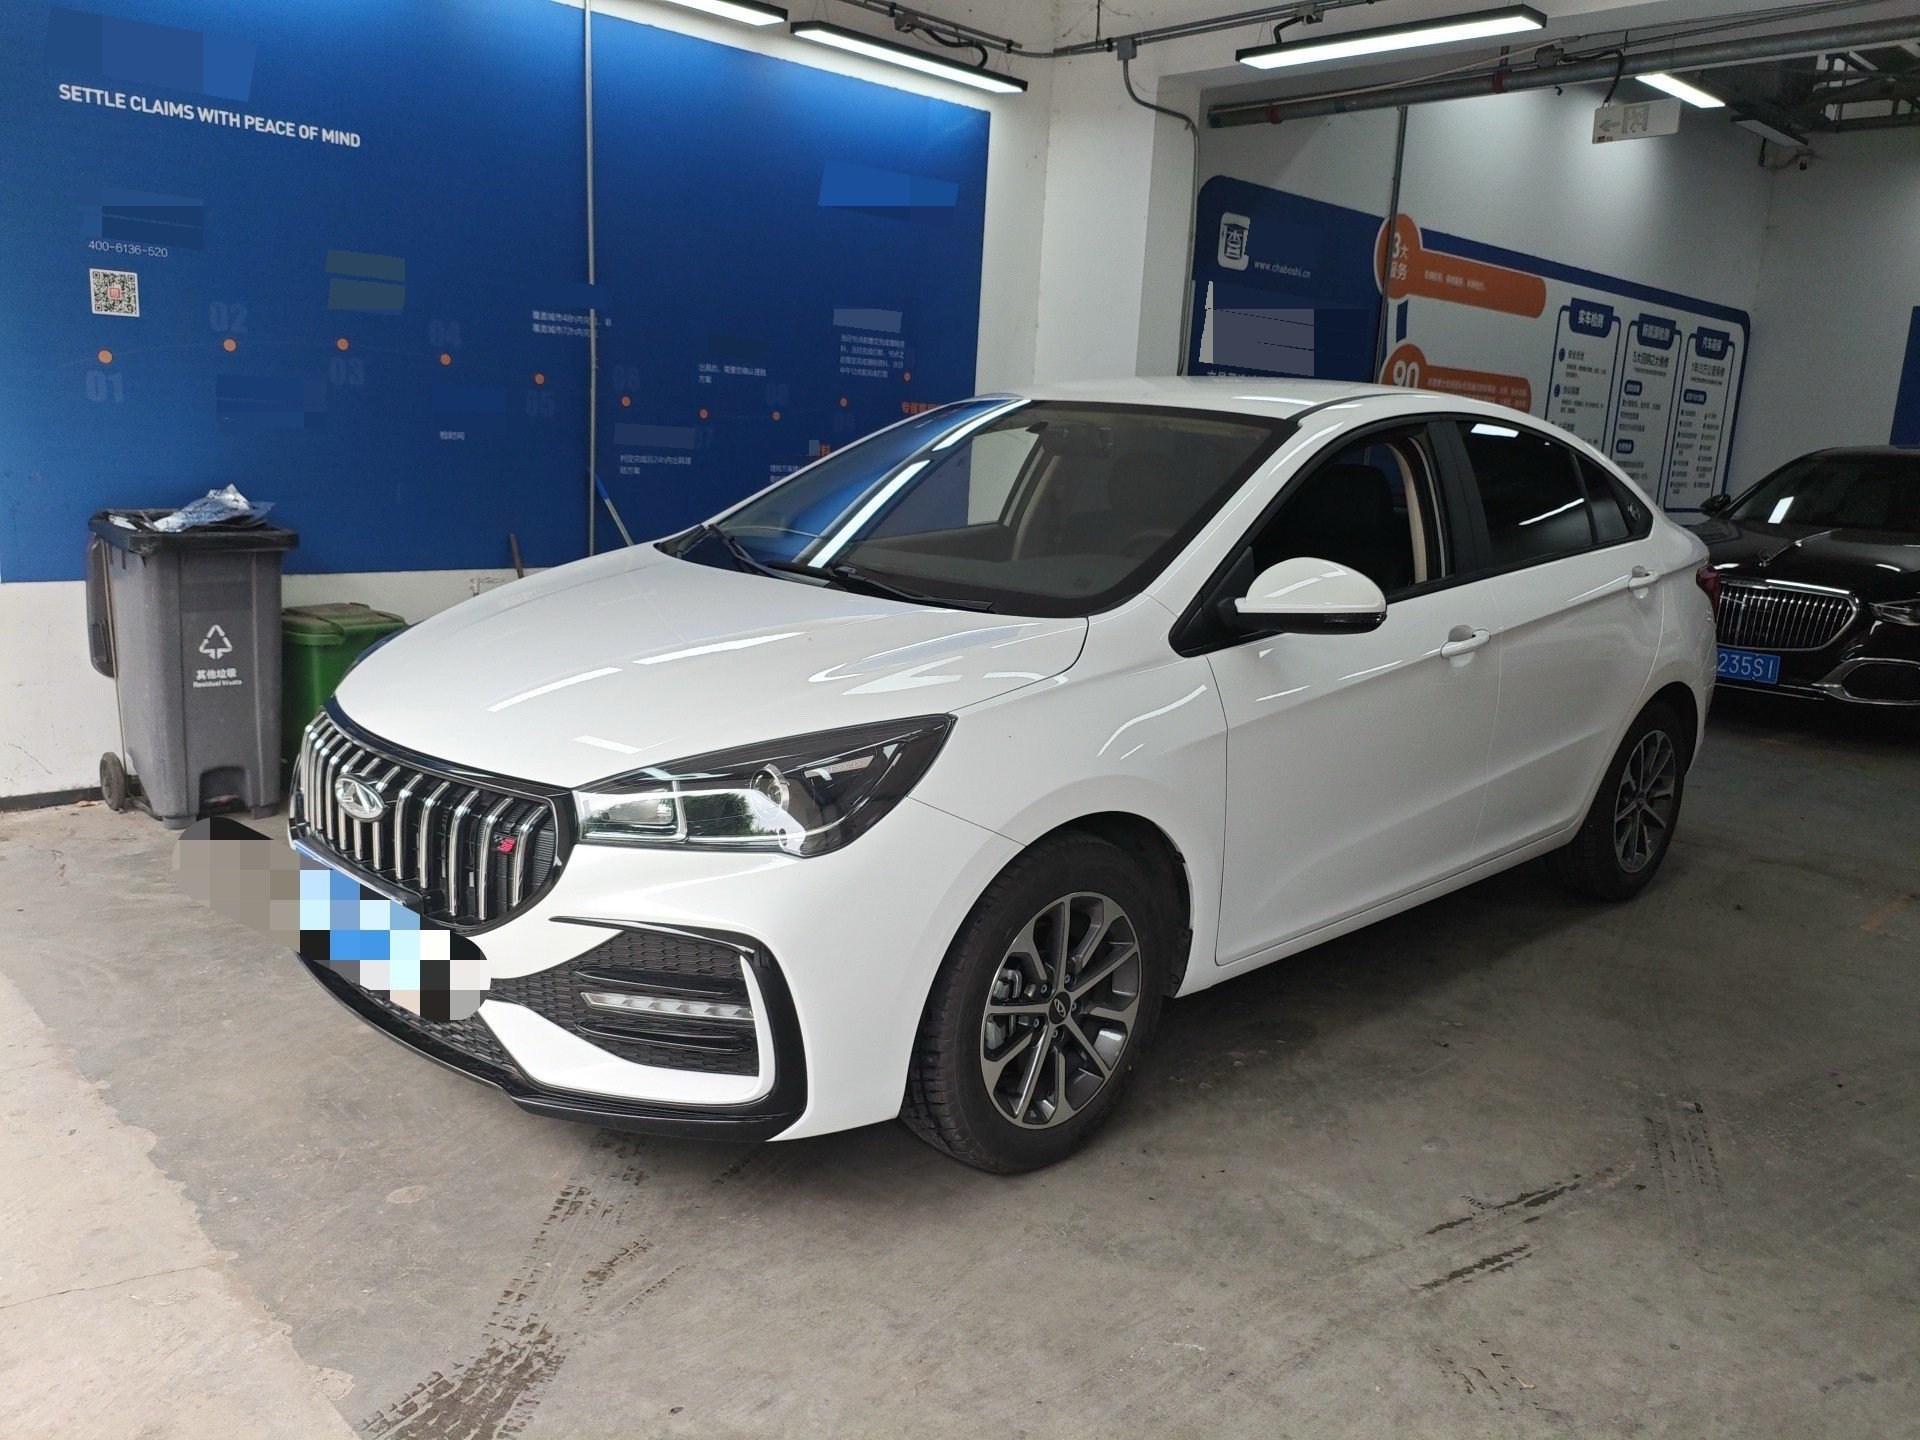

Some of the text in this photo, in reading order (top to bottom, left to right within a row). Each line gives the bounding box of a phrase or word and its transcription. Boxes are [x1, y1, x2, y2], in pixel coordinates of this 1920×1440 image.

[58, 83, 361, 148] SETTLE CLAIMS WITH PEACE OF MIND
[88, 240, 168, 258] 400-6136-520
[1254, 260, 1311, 279] www.chaboshi.cn
[209, 301, 248, 335] 02
[429, 319, 462, 348] 04
[328, 356, 366, 387] 03
[85, 370, 124, 404] 01
[196, 667, 237, 681] 其他垃圾
